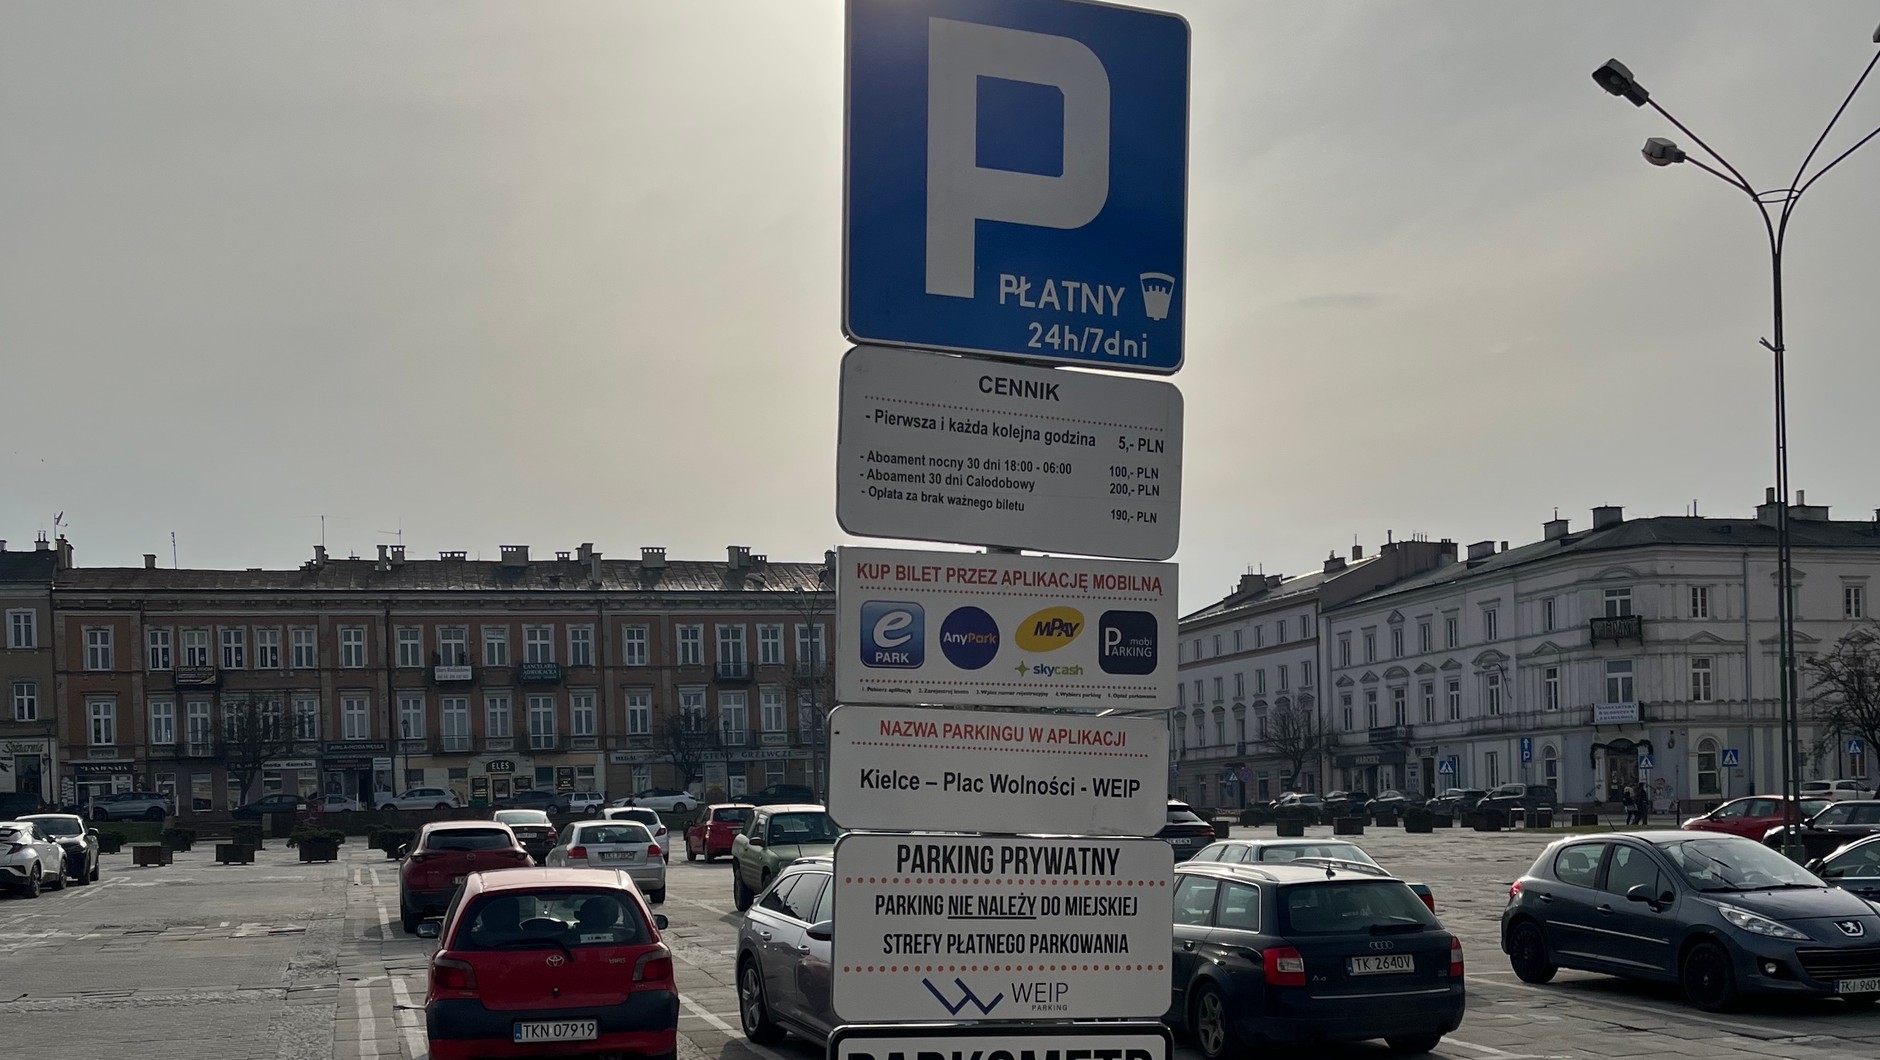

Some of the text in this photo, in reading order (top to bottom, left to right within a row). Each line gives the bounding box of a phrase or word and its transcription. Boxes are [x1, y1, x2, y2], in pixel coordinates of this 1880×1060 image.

[925, 16, 1111, 298] P
[999, 274, 1126, 316] PŁATNY
[1028, 323, 1147, 358] 24h/7dni
[978, 375, 1060, 401] CENNIK
[875, 409, 937, 431] Pierwsza
[941, 416, 944, 431] i
[949, 417, 988, 437] każda
[992, 421, 1041, 443] kolejna
[1044, 427, 1096, 447] godzina
[1118, 436, 1134, 452] 5,-
[1138, 438, 1164, 454] PLN
[867, 450, 926, 466] Aboament
[929, 456, 964, 471] nocny
[967, 457, 980, 470] 30
[983, 458, 1001, 471] dni
[1004, 459, 1033, 473] 18:00
[1043, 461, 1072, 475] 06:00
[1109, 465, 1134, 480] 100,-
[1137, 467, 1159, 479] PLN
[866, 468, 926, 485] Aboament
[928, 473, 942, 486] 30
[945, 474, 963, 487] dni
[1109, 482, 1134, 497] 200,-
[1137, 484, 1160, 497] PLN
[868, 486, 903, 503] Opłata
[905, 491, 918, 501] za
[920, 490, 944, 504] brak
[947, 493, 993, 511] ważnego
[995, 497, 1025, 512] biletu
[1110, 509, 1134, 523] 190,-
[1137, 511, 1157, 523] PLN
[857, 563, 1163, 596] KUP BILET PRZEZ APLIKACJĘ MOBILNĄ
[943, 631, 997, 645] AnyPark
[1129, 637, 1153, 646] mobi
[875, 651, 909, 664] PARK
[1033, 663, 1083, 677] skycash
[880, 720, 1126, 747] NAZWA PARKINGU W APLIKACJI
[860, 768, 920, 790] Kielce
[943, 771, 984, 793] Plac
[990, 773, 1075, 796] Wolności
[1092, 778, 1140, 798] WEIP
[897, 844, 1120, 876] PARKING PRYWATNY
[875, 892, 1138, 917] PARKING NIE NALEŻY DO MIEJSKIEJ
[883, 933, 1129, 954] STREFY PŁATNEGO PARKOWANIA
[1355, 956, 1411, 971] TK 2640V
[1011, 982, 1068, 1003] WEIP
[523, 1021, 595, 1040] TKN 07919
